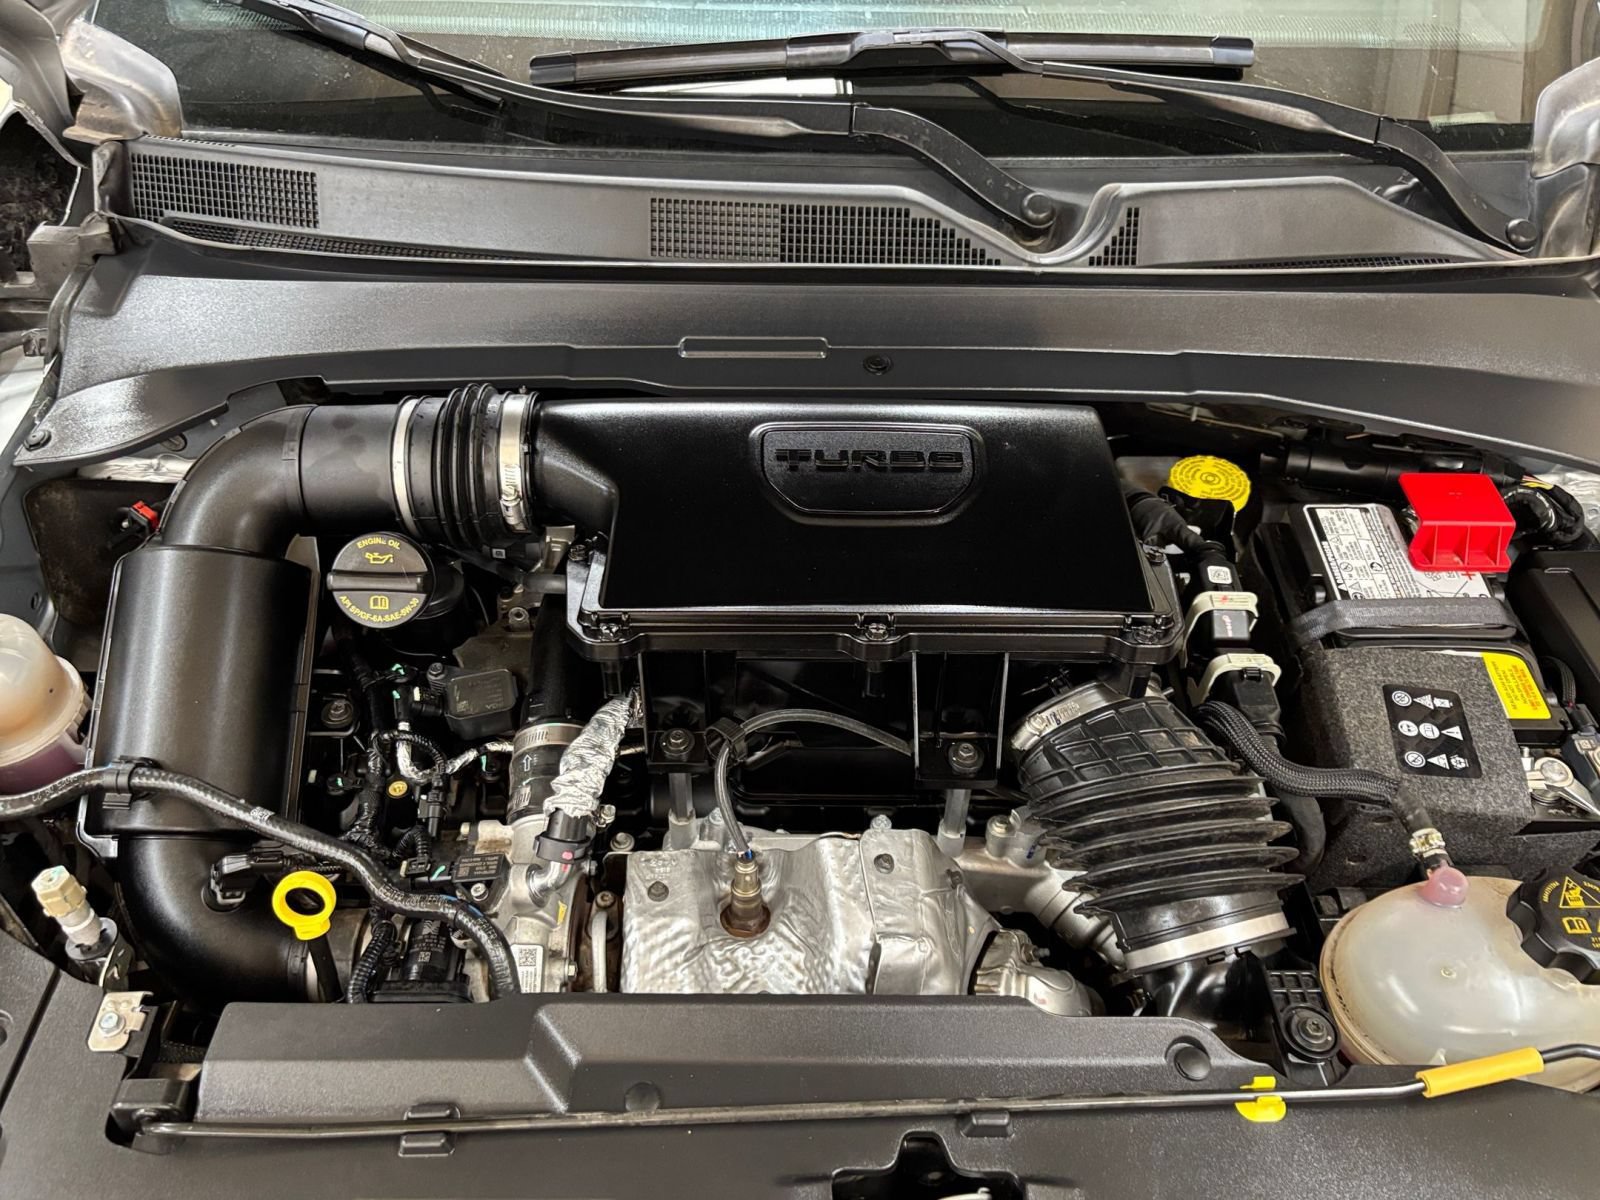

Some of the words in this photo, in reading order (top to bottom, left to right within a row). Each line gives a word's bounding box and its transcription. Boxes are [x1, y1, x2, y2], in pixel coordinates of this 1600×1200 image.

[775, 449, 965, 474] TURBO
[388, 539, 401, 550] OIL
[339, 595, 352, 609] API
